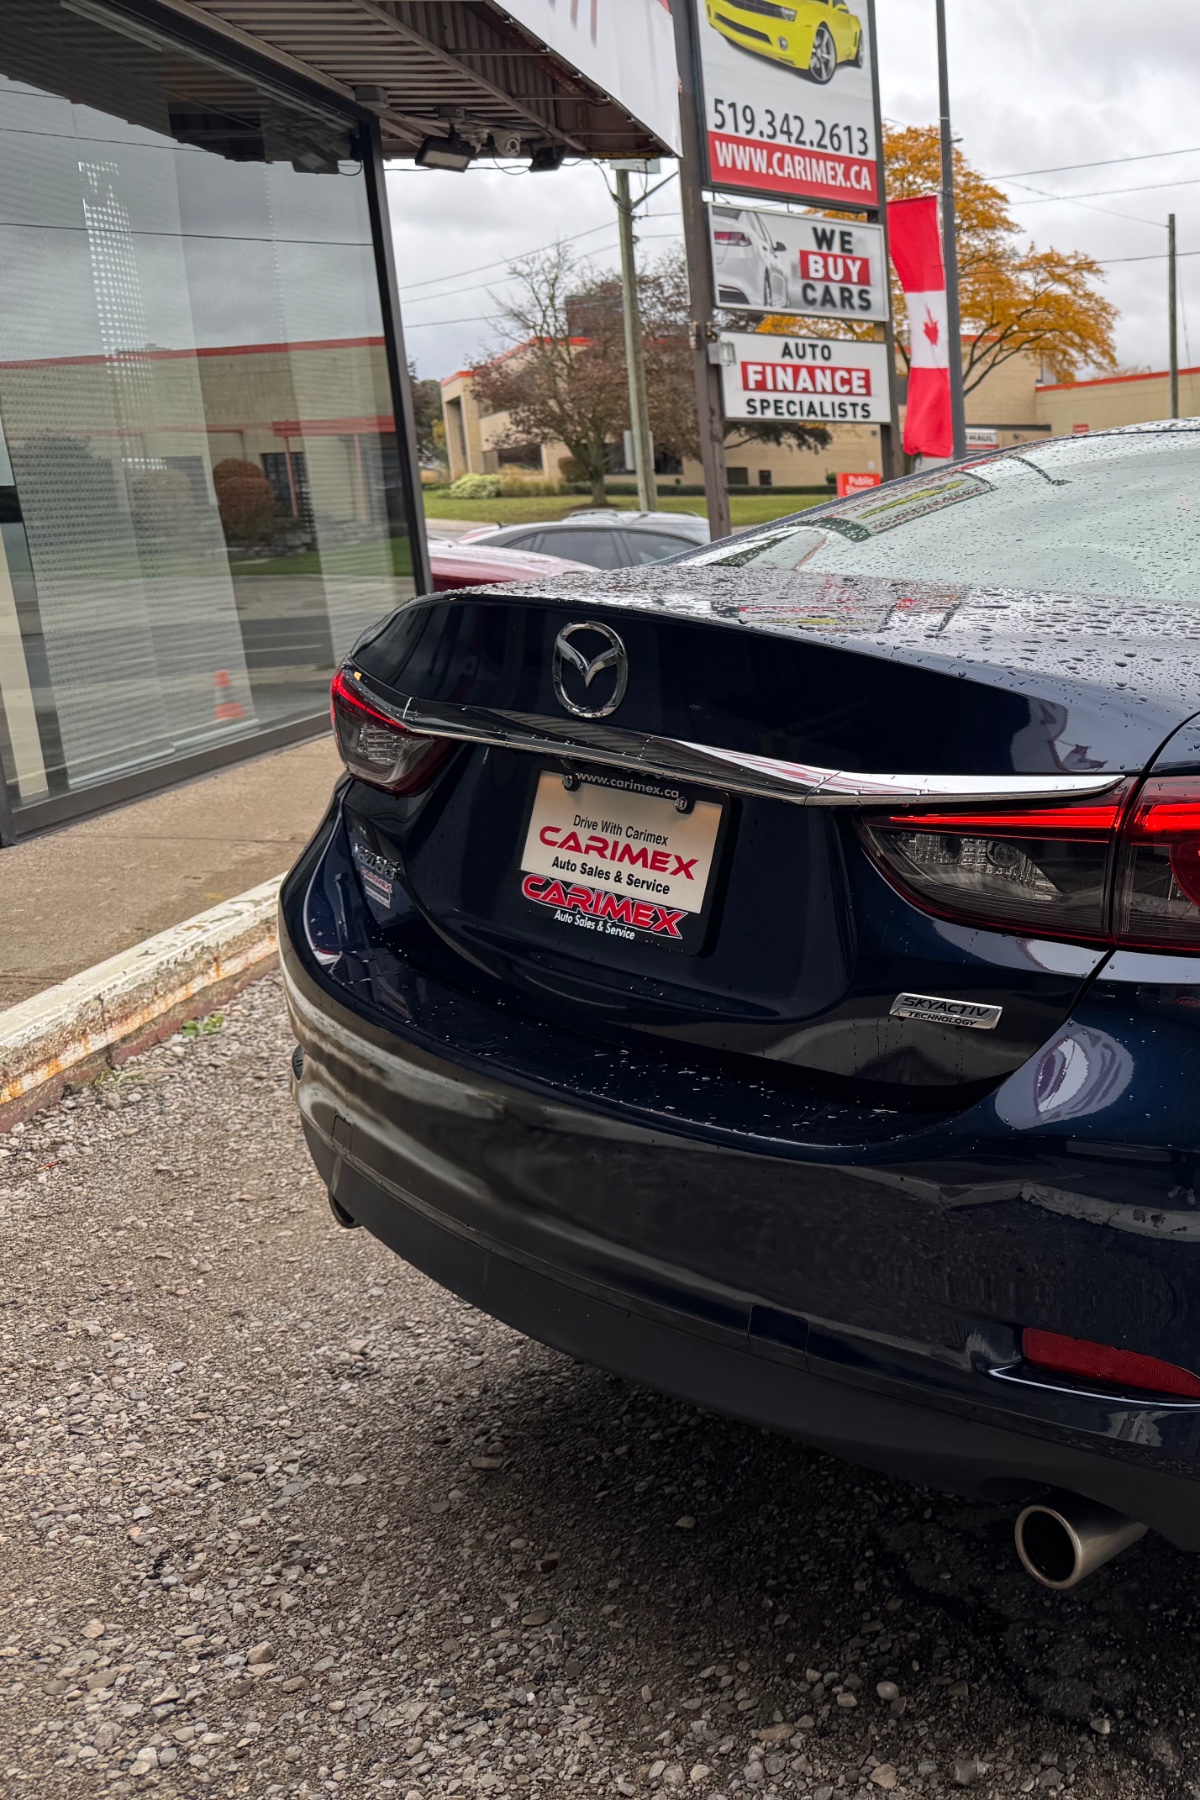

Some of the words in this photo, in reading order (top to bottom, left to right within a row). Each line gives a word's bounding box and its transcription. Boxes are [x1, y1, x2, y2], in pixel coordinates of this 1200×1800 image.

[714, 98, 868, 156] 519.342.2613
[714, 140, 872, 191] WWW.CARIMEX.CA
[812, 227, 853, 253] WE
[808, 254, 862, 283] BUY
[802, 283, 872, 311] CARS
[781, 342, 832, 361] AUTO
[746, 364, 867, 394] FINANCE
[746, 398, 871, 419] SPECIALISTS
[848, 475, 874, 485] Public
[577, 772, 679, 798] www.carimex.ca
[573, 814, 598, 830] Drive
[601, 820, 623, 837] With
[625, 825, 669, 846] Carimex
[539, 826, 699, 880] CARIMEX
[552, 856, 577, 873] Auto
[579, 862, 611, 880] Sales
[614, 871, 623, 883] &
[626, 873, 670, 895] Service
[523, 875, 685, 938] CARIMEX
[554, 910, 574, 924] Auto
[574, 915, 595, 930] Sales
[597, 920, 604, 932] &
[605, 922, 635, 940] Service
[901, 997, 990, 1017] SKYACTIV
[908, 1011, 977, 1026] TECHNOLOGY
